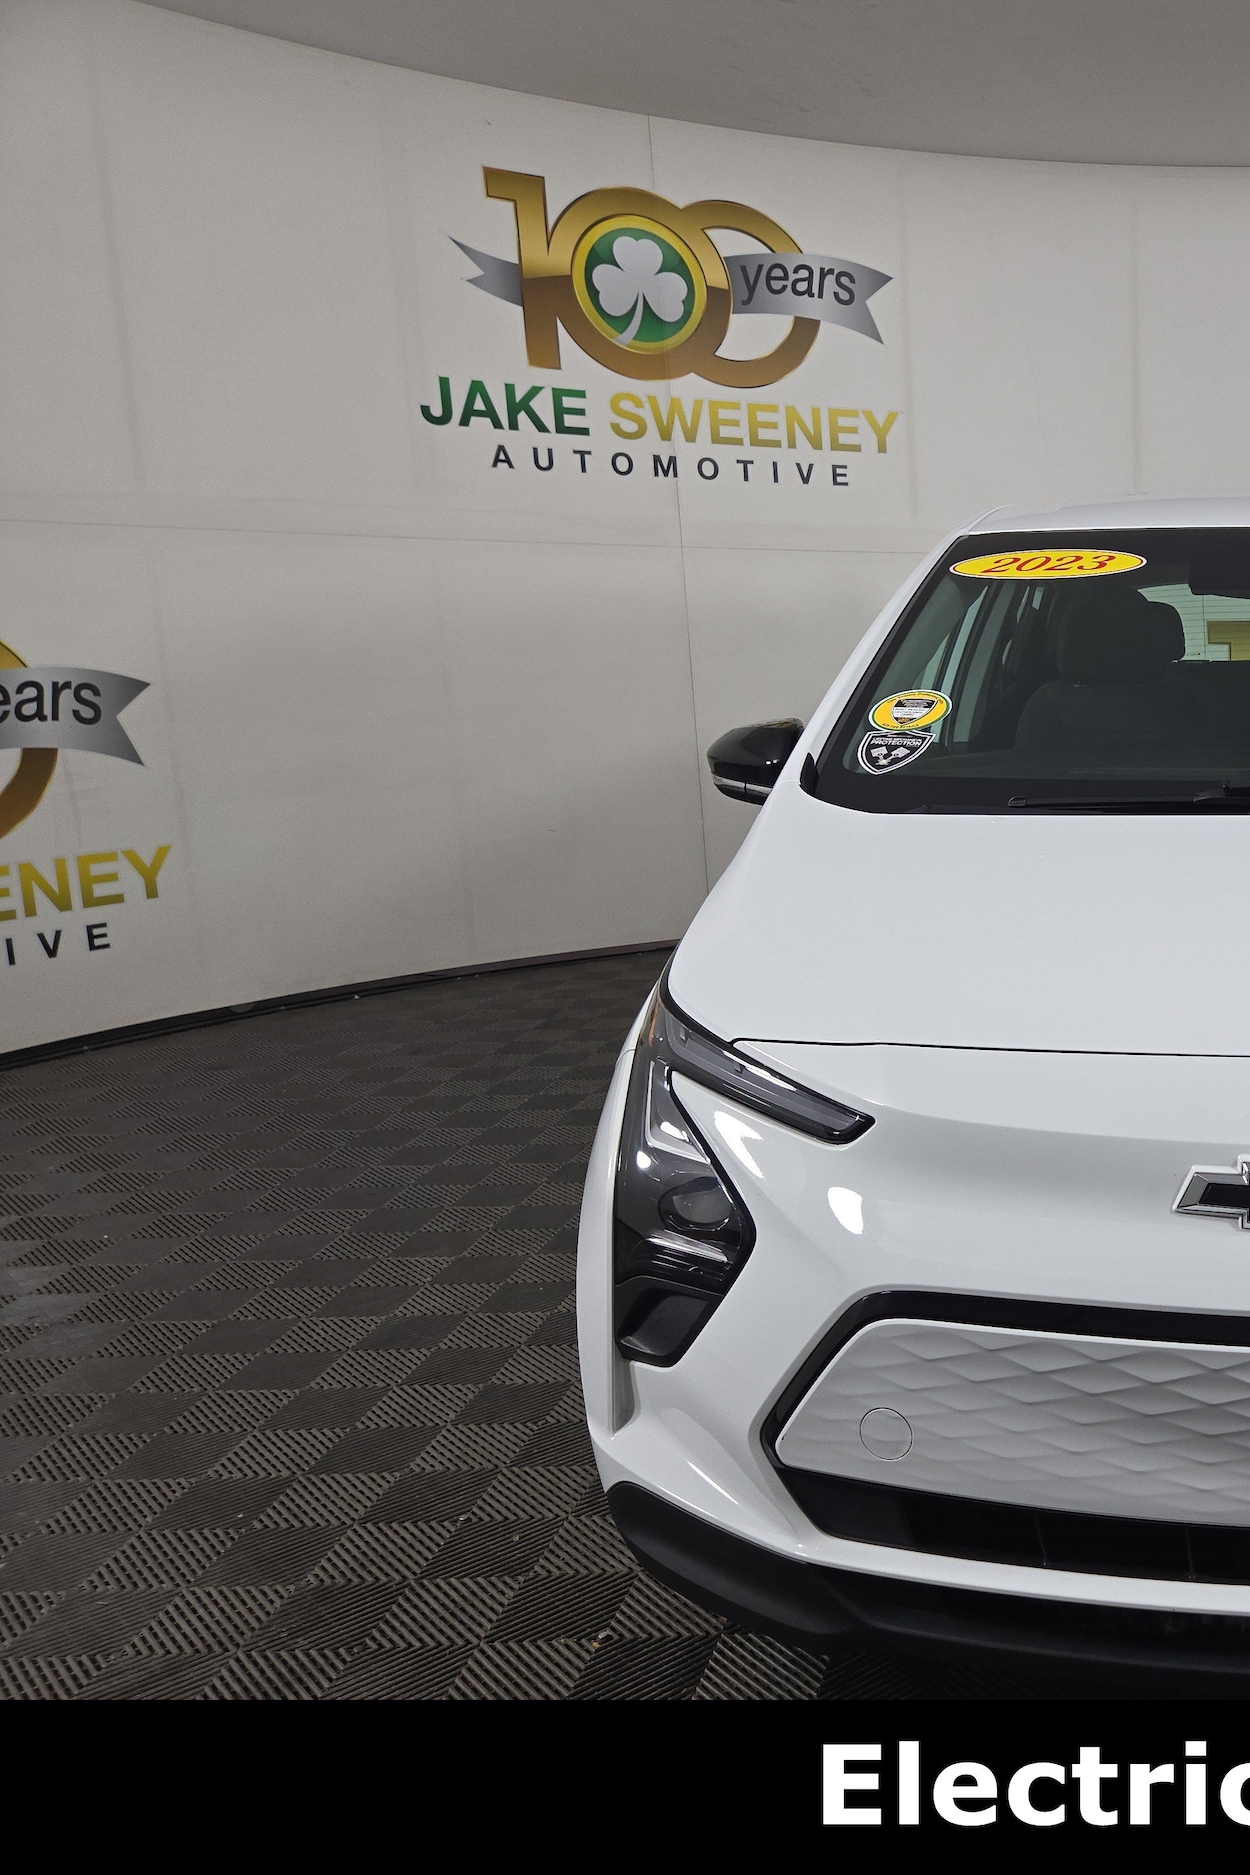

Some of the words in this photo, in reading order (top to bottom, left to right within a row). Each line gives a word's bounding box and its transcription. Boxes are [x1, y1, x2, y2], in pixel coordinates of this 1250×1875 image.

[740, 261, 857, 306] years
[420, 376, 590, 436] JAKE
[609, 391, 900, 454] SWEENEY
[491, 444, 849, 487] AUTOMOTIVE
[980, 555, 1116, 573] 2023
[870, 739, 922, 747] PROTECTION
